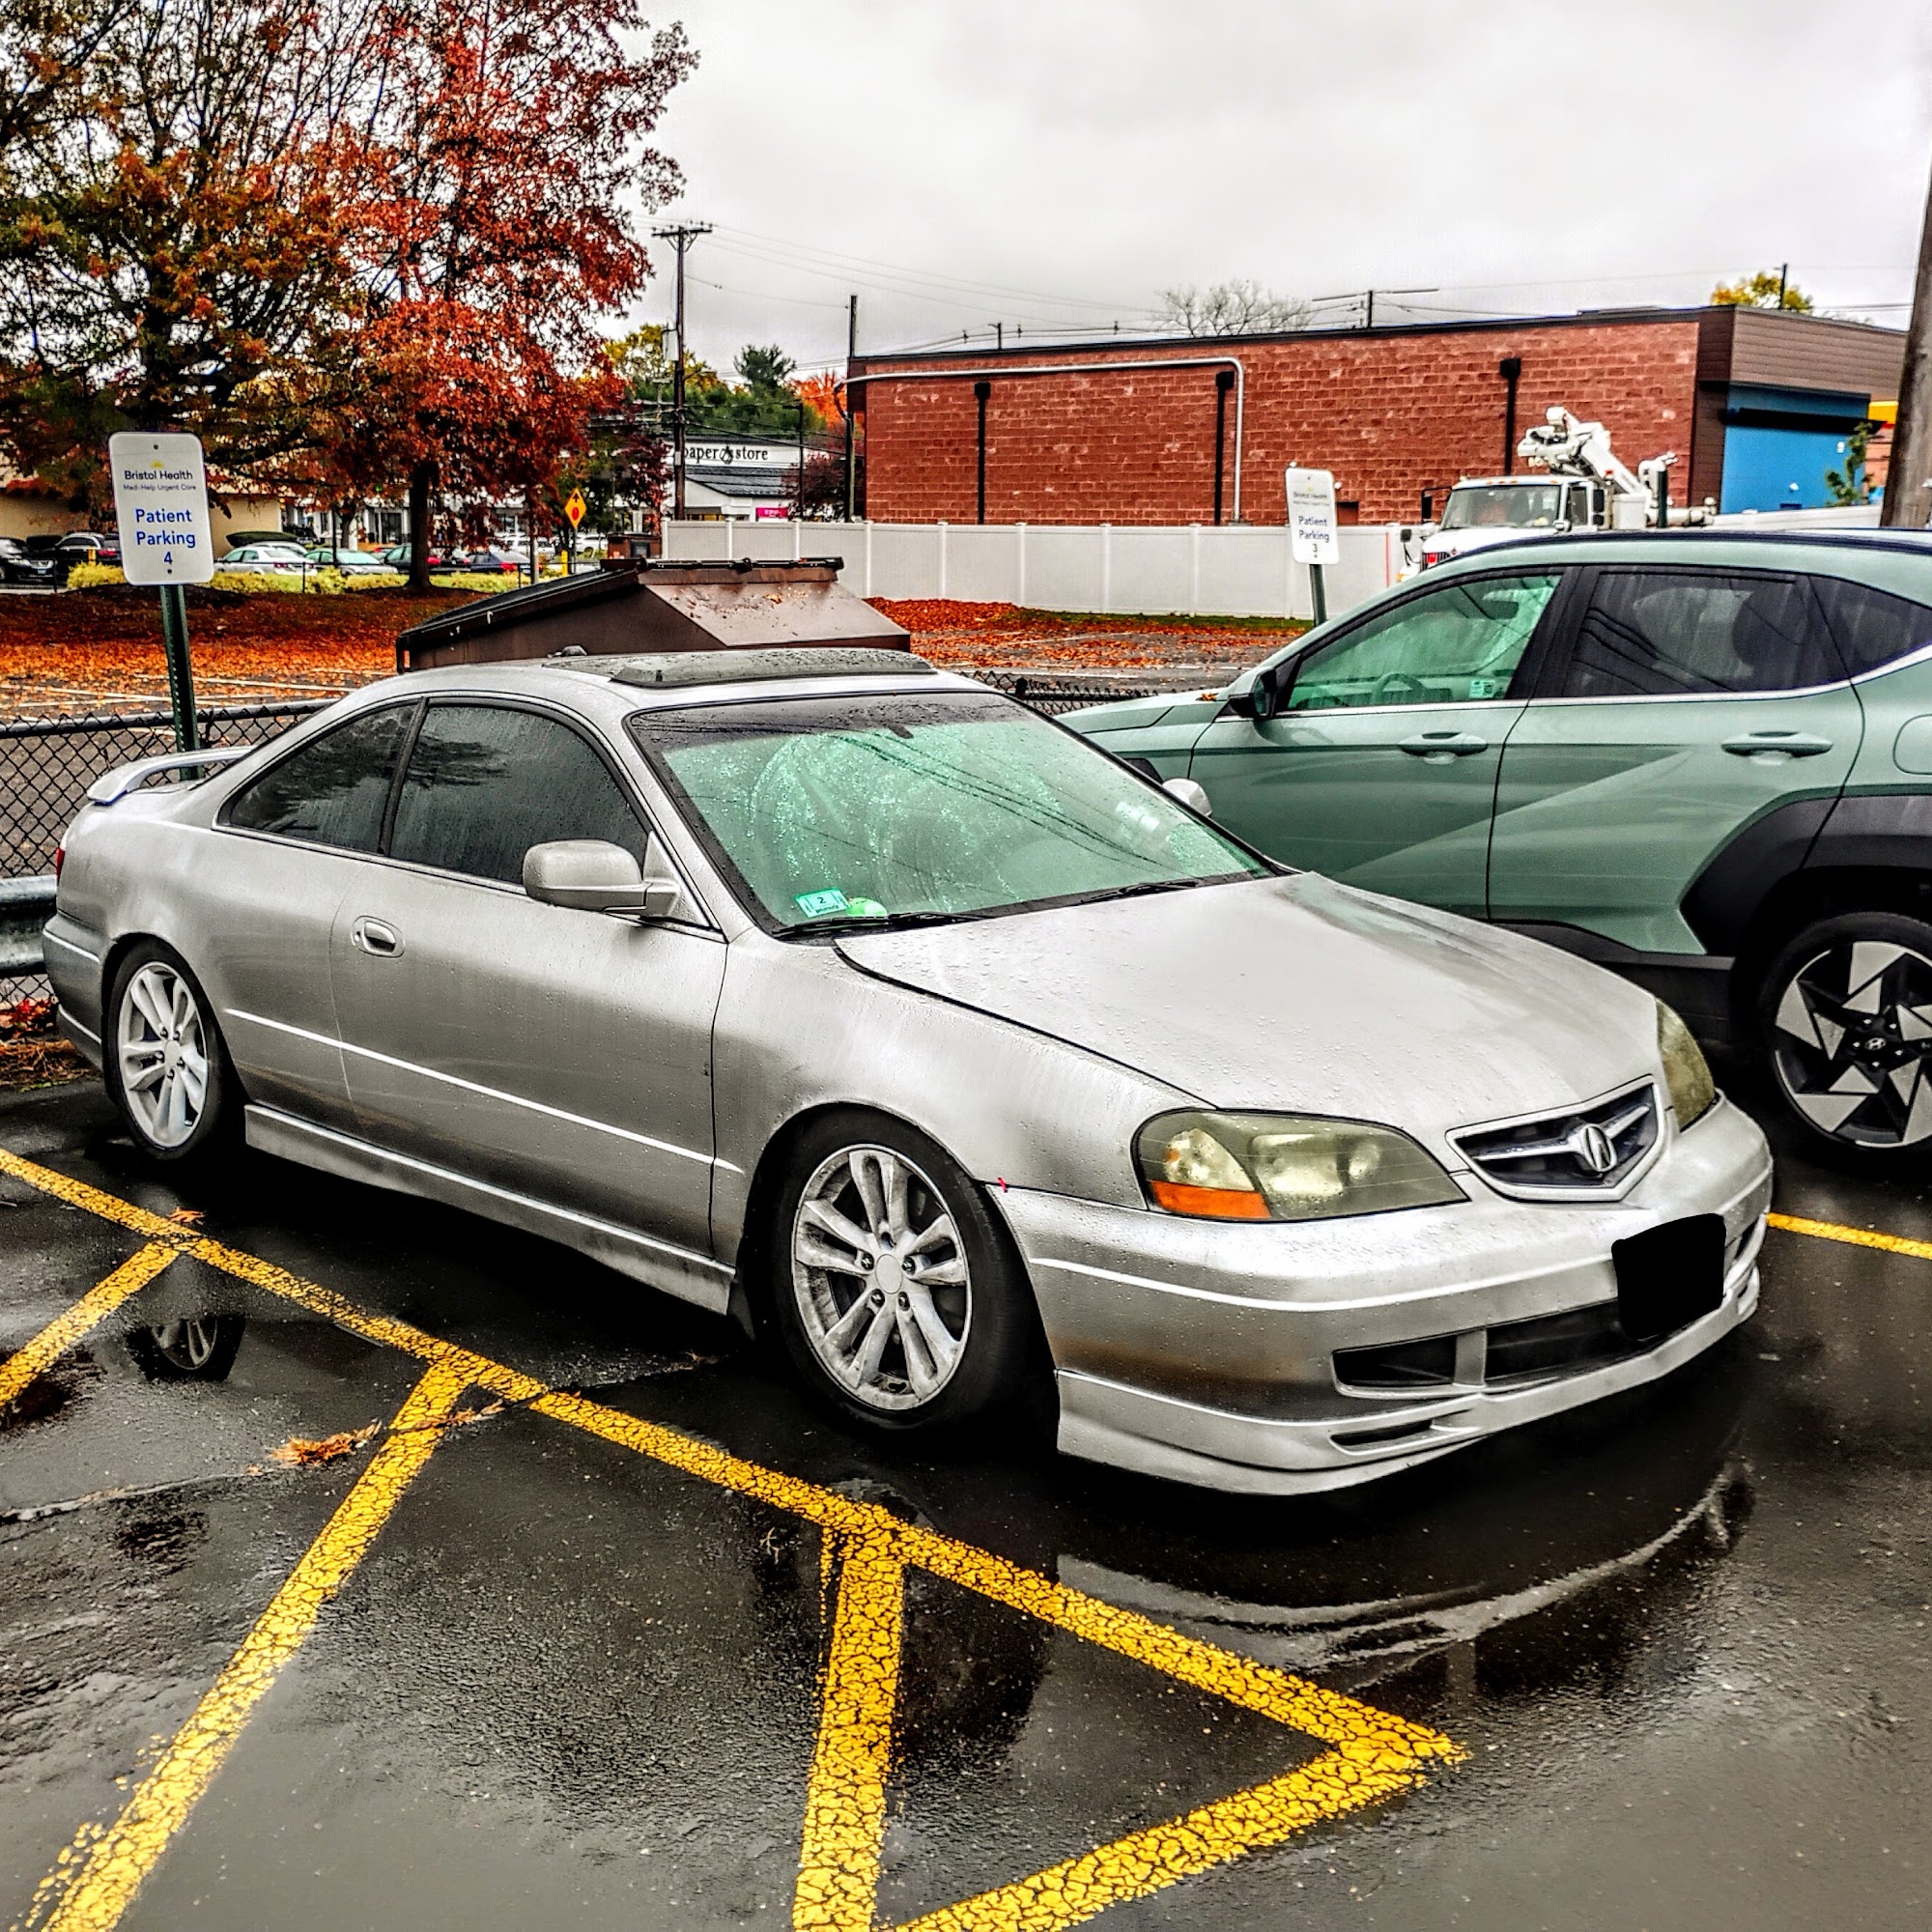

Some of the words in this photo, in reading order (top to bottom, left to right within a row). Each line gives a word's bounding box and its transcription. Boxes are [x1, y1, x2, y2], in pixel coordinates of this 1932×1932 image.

[735, 446, 769, 461] store
[124, 470, 157, 480] Bristol
[159, 470, 193, 480] Health
[135, 508, 192, 523] Patient
[1298, 515, 1328, 526] Patient
[136, 529, 196, 549] Parking
[1299, 529, 1330, 544] Parking
[1313, 543, 1318, 553] 3
[163, 551, 173, 565] 4
